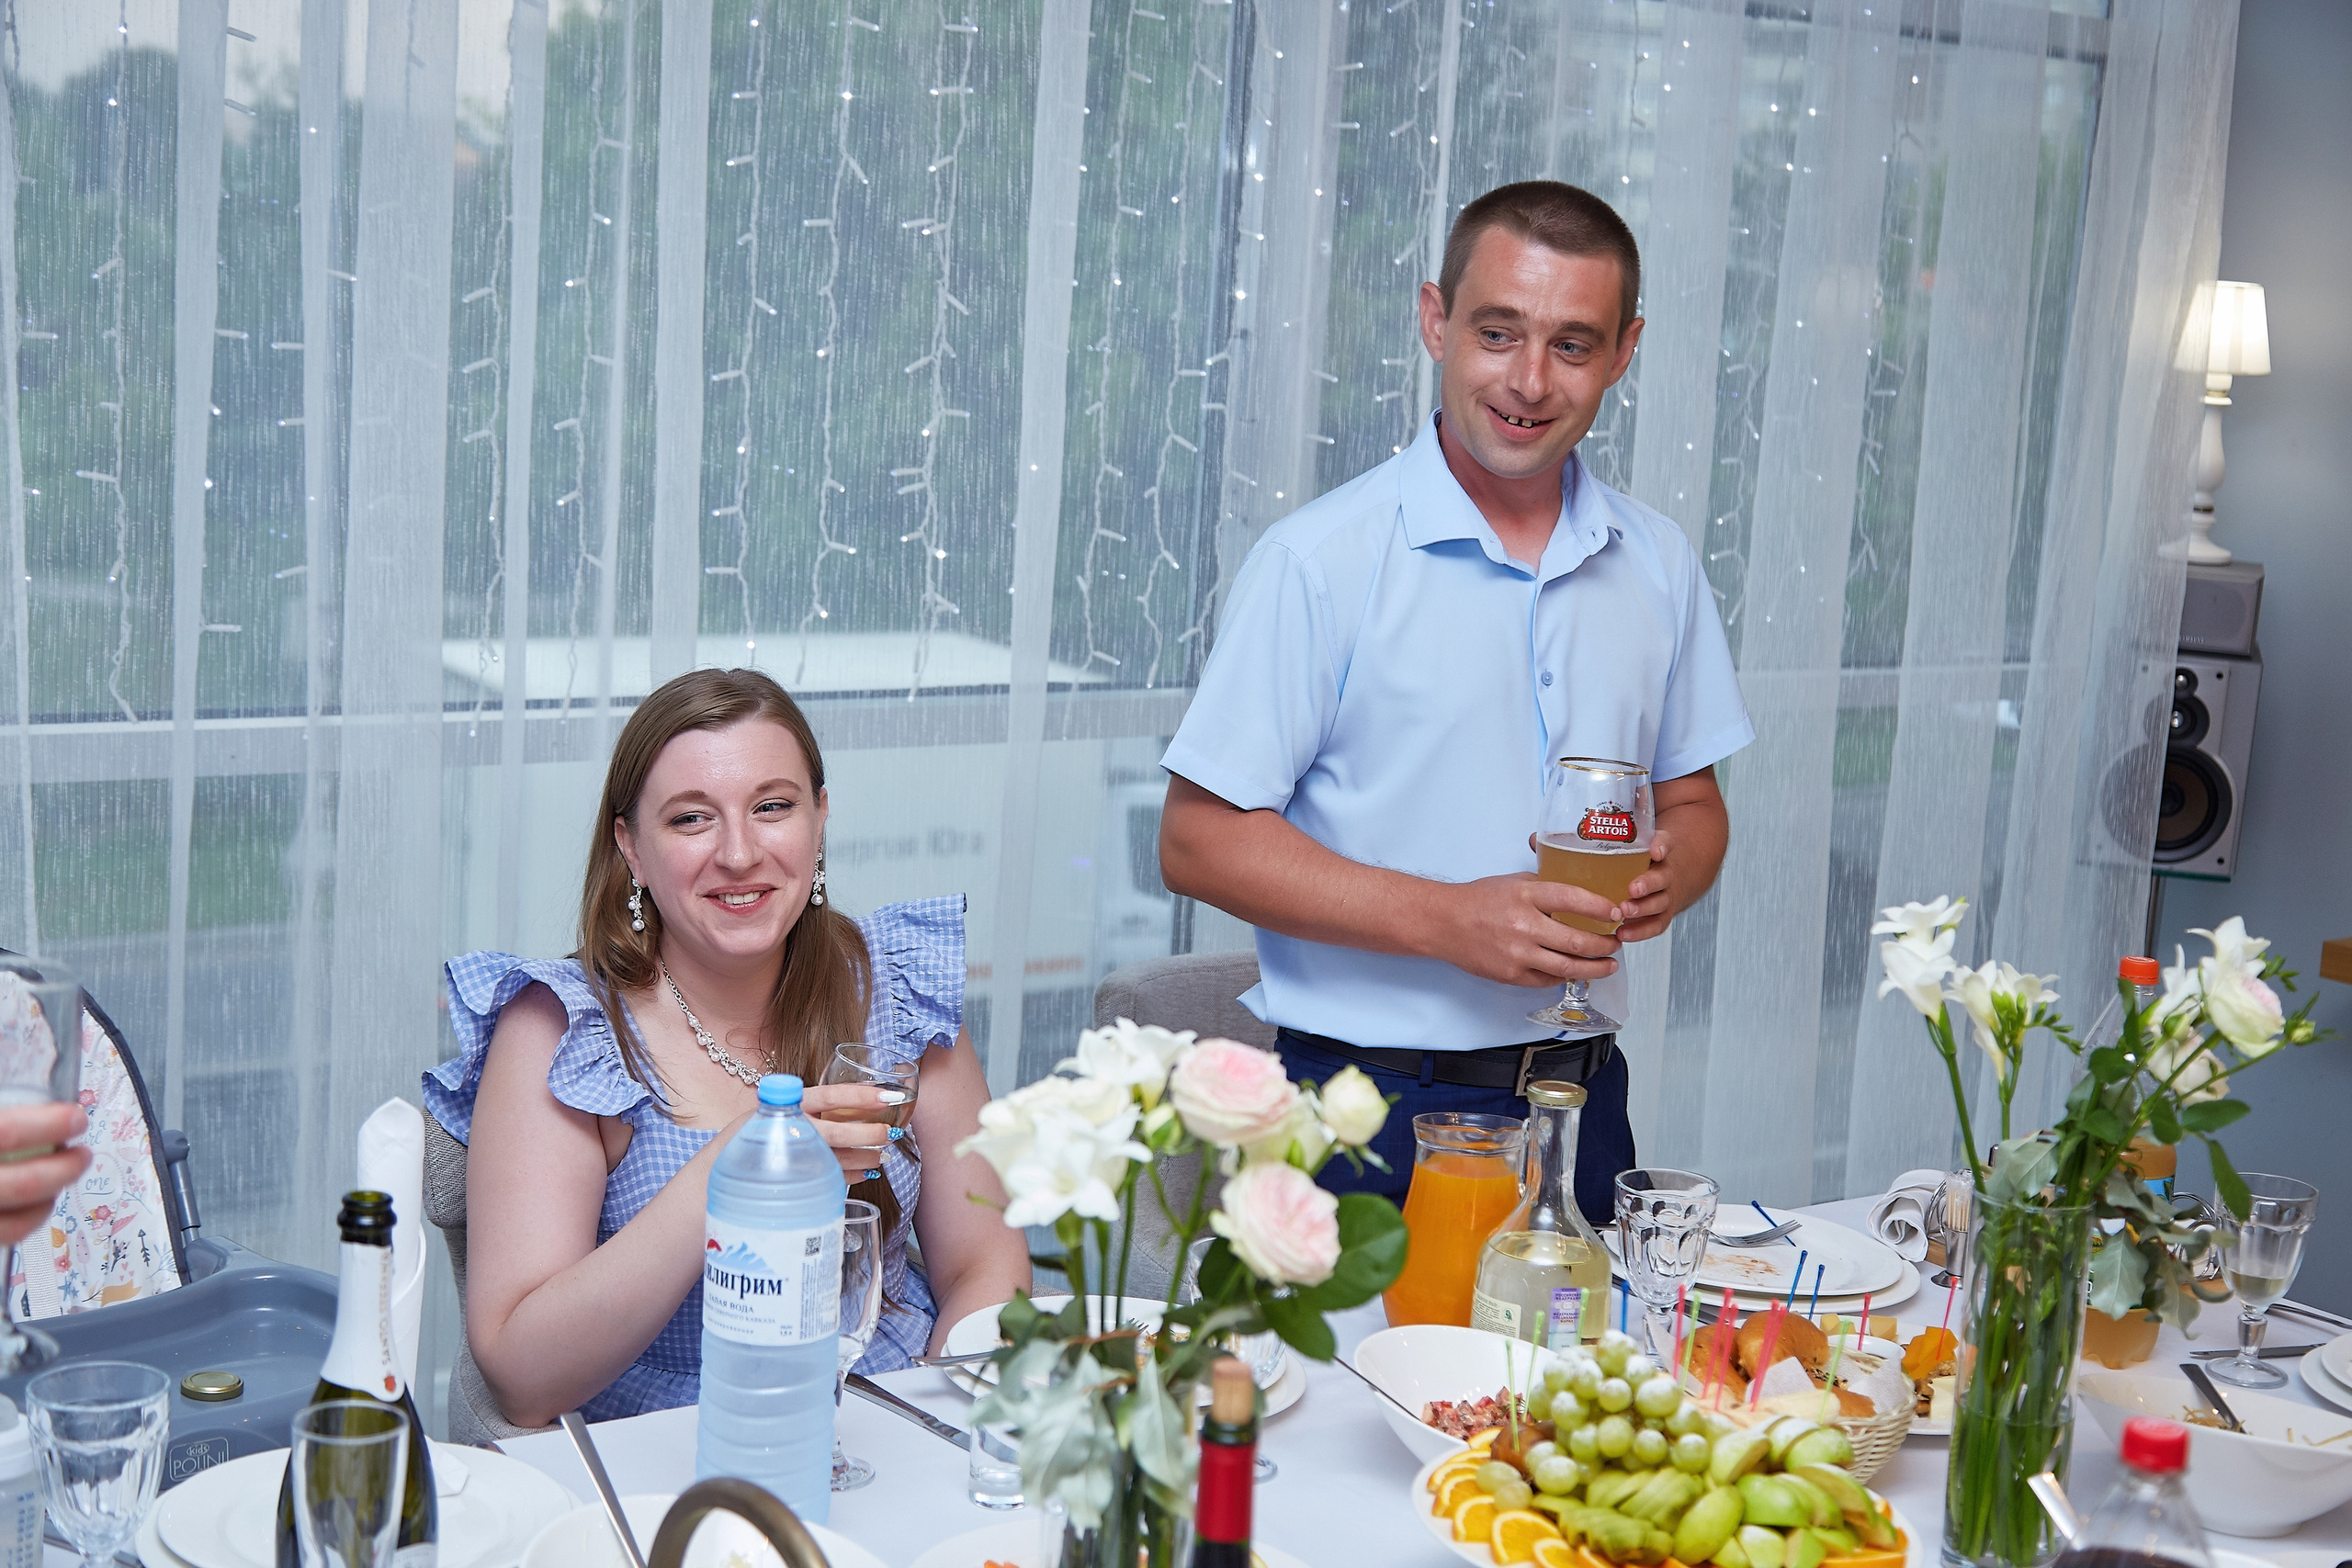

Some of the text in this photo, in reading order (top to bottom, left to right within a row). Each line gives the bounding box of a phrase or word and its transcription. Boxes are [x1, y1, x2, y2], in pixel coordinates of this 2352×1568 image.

[1589, 816, 1628, 827] STELLA
[1589, 825, 1629, 836] ARTOIS
[85, 1177, 110, 1190] one
[705, 1262, 783, 1300] илигрим
[729, 1302, 754, 1314] ВОДА
[189, 1443, 209, 1456] kids
